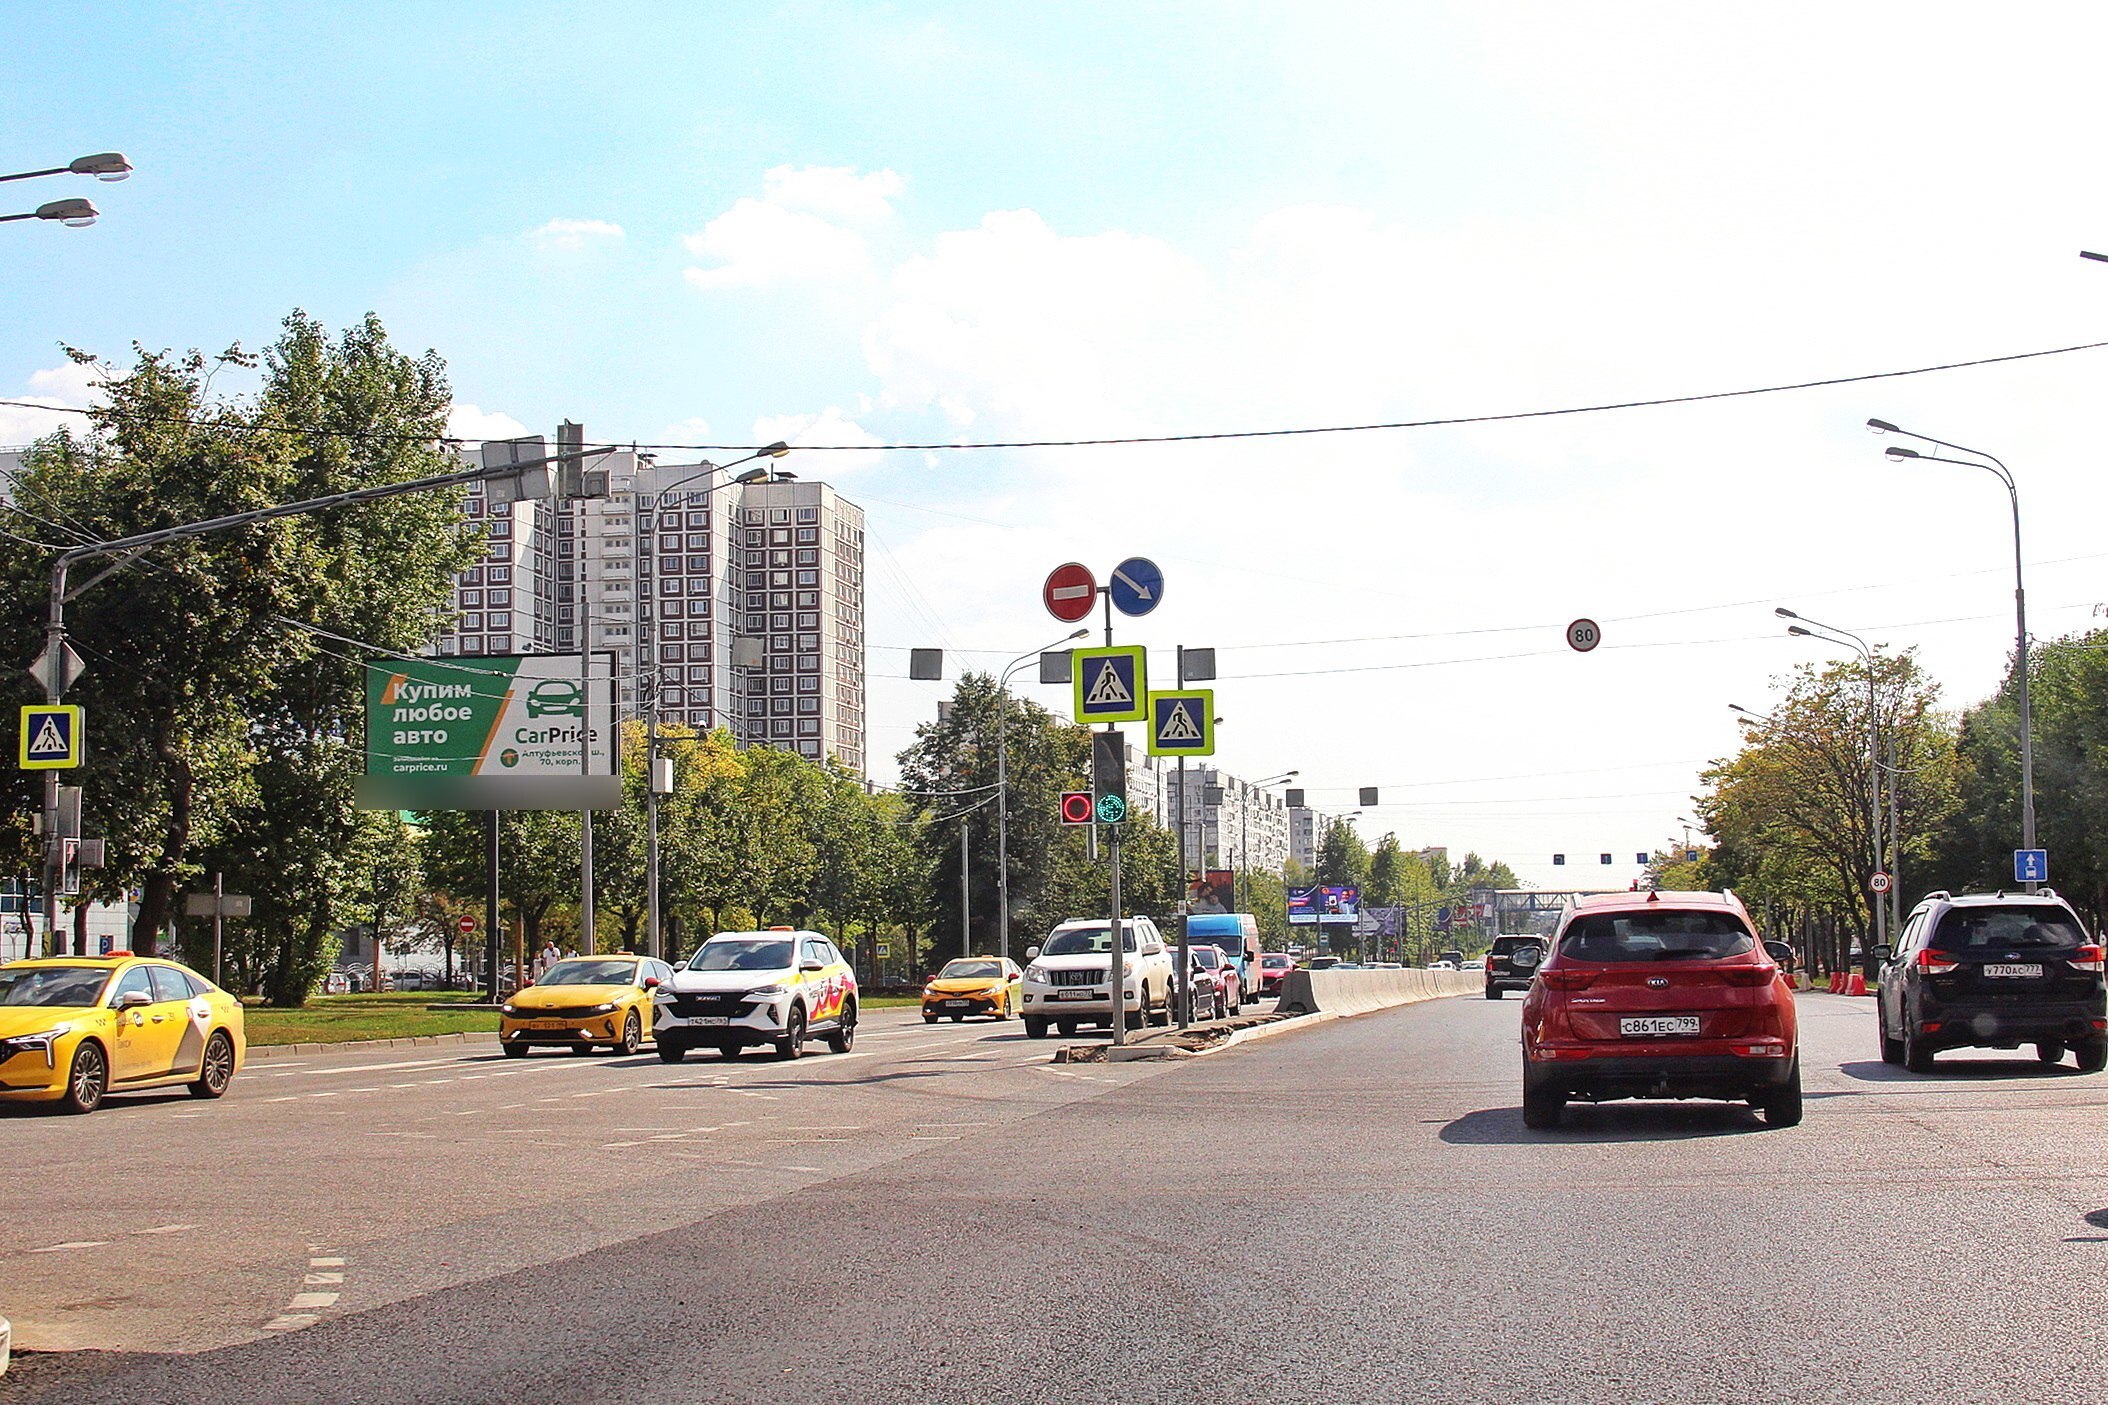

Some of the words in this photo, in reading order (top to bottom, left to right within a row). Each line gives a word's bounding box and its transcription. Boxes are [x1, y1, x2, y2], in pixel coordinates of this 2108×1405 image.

[1575, 628, 1593, 642] 80
[393, 682, 472, 704] Купим
[392, 702, 472, 722] любое
[392, 729, 448, 744] авто
[521, 750, 583, 758] Алтуфьевско
[392, 762, 448, 774] carprice.ru
[1873, 878, 1886, 887] 80
[1624, 1019, 1675, 1033] С861ЕС
[1677, 1018, 1696, 1028] 799
